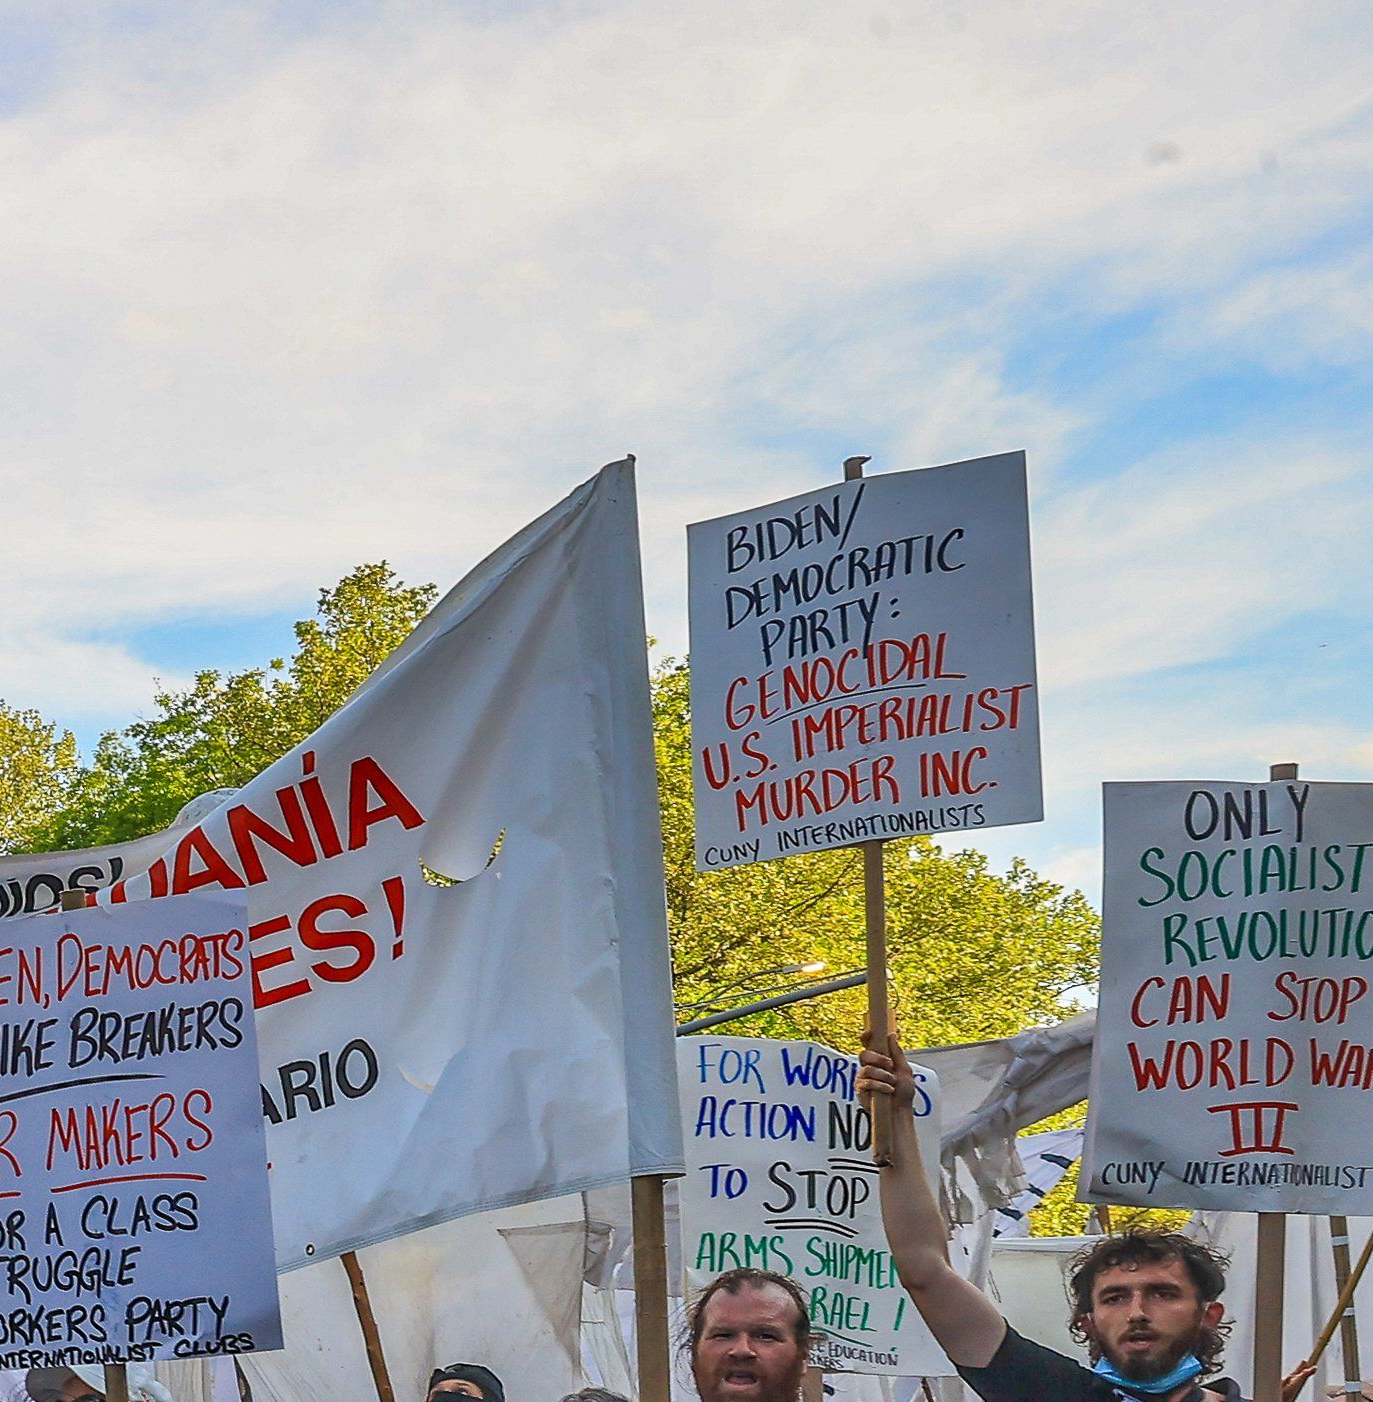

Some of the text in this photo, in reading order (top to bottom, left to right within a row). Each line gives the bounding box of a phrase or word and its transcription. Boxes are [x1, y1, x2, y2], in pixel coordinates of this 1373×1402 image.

[727, 483, 866, 574] BIDEN/
[724, 528, 966, 630] DEMOCRATIC
[759, 591, 900, 667] PARTY:
[725, 632, 967, 732] GENOCIDAL
[701, 683, 1033, 791] U.S. IMPERIALIST
[736, 746, 998, 832] MURDER INC.
[1185, 784, 1310, 842] ONLY
[705, 803, 986, 865] CUNY INTERNATIONALISTS
[1138, 842, 1373, 908] SOCIALIST
[56, 929, 244, 1001] DEMOCRATS
[1131, 970, 1369, 1029] CAN STOP
[68, 997, 244, 1070] BREAKERS
[697, 1043, 766, 1095] FOR
[1127, 1037, 1295, 1092] WORLD
[46, 1089, 213, 1172] MAKERS
[695, 1095, 815, 1142] ACTION
[1206, 1101, 1300, 1156] III
[699, 1161, 870, 1219] TO STOP
[1102, 1160, 1371, 1194] CUNY INTERNATIONALIST
[44, 1202, 64, 1245] A
[80, 1192, 199, 1242] CLASS
[696, 1232, 793, 1277] ARMS
[125, 1295, 230, 1342] PARTY
[173, 1333, 256, 1357] CLUBS
[829, 1342, 898, 1365] EDUCATION
